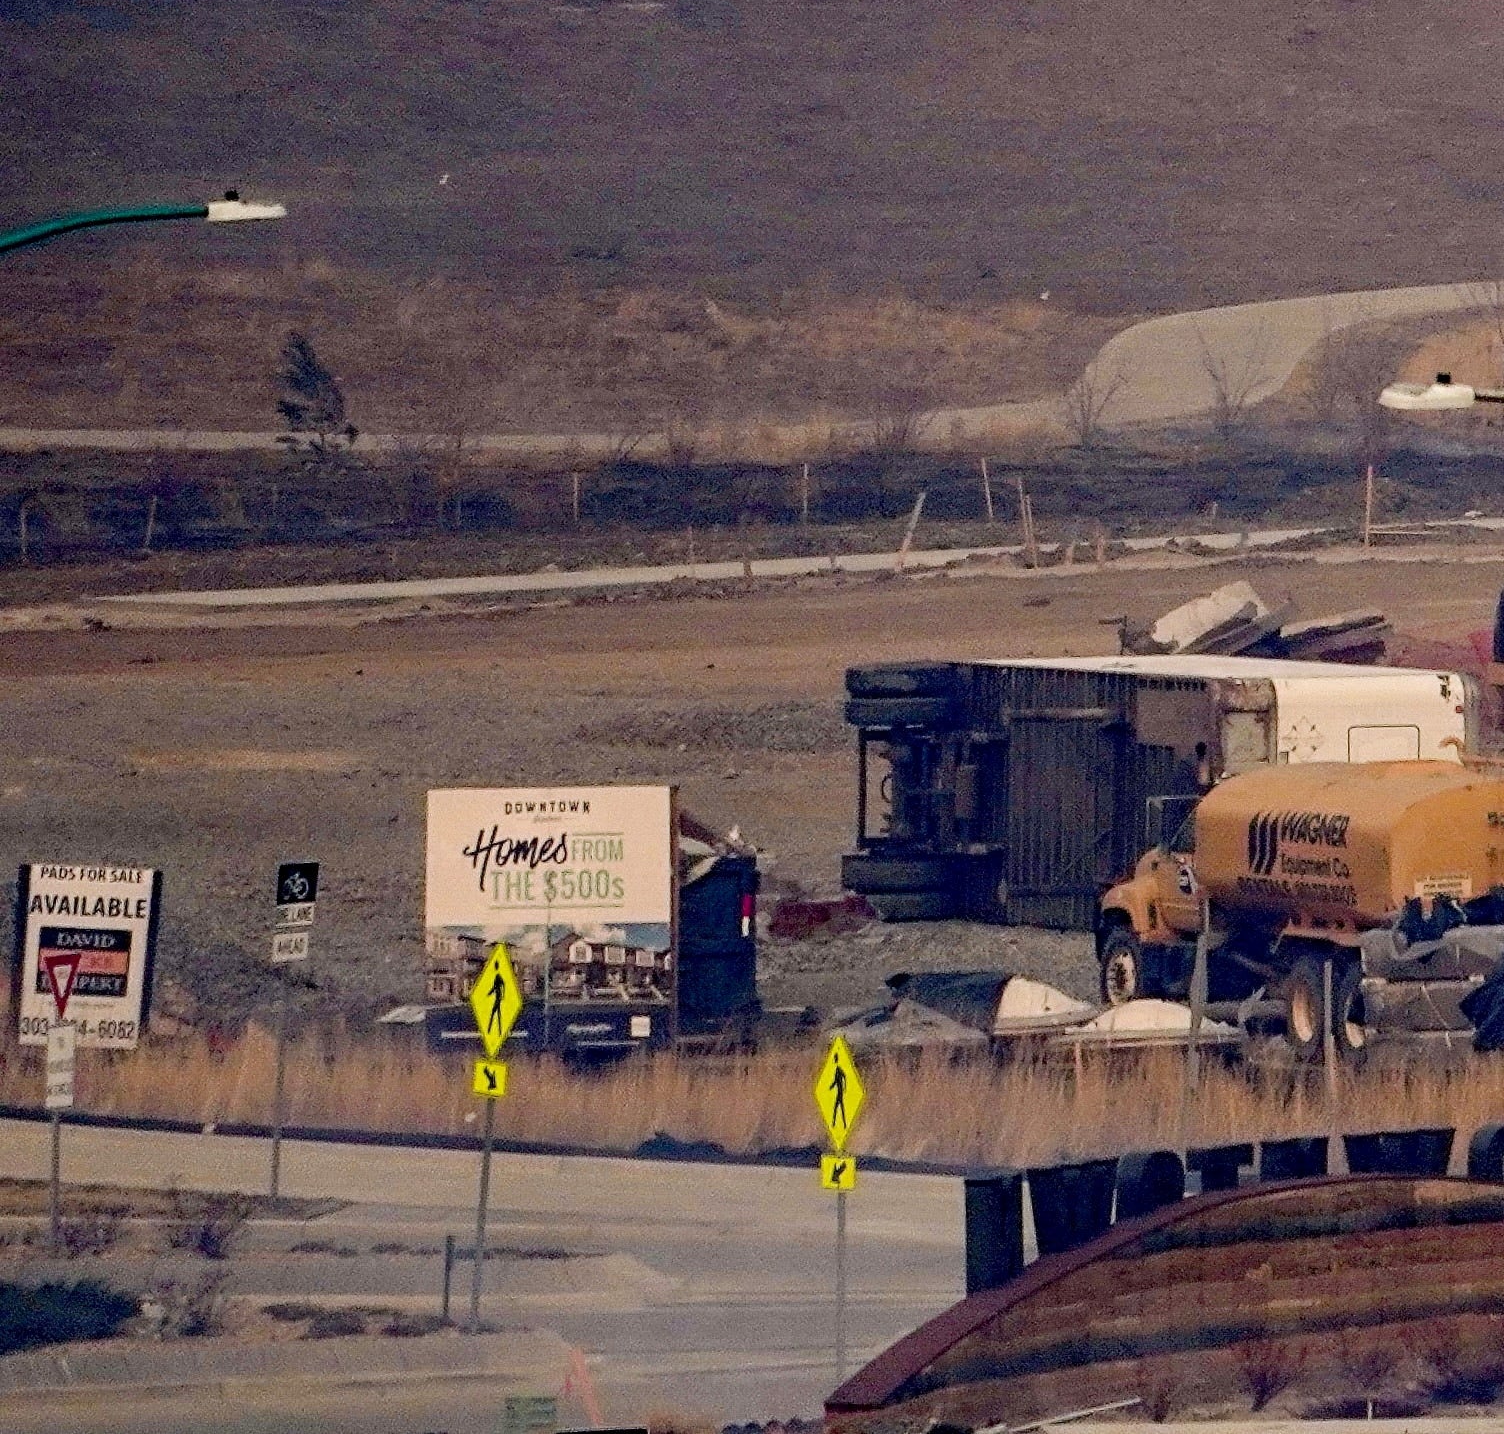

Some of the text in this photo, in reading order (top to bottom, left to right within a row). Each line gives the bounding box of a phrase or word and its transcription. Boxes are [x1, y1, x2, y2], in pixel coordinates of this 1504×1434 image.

[505, 801, 591, 814] DOWNTOWN
[1281, 812, 1349, 848] WAGNER
[463, 825, 624, 891] Homes FROM
[41, 867, 143, 884] PADS FOR SALE
[491, 871, 536, 900] THE
[31, 894, 147, 918] AVAILABLE
[57, 932, 116, 948] DAVID
